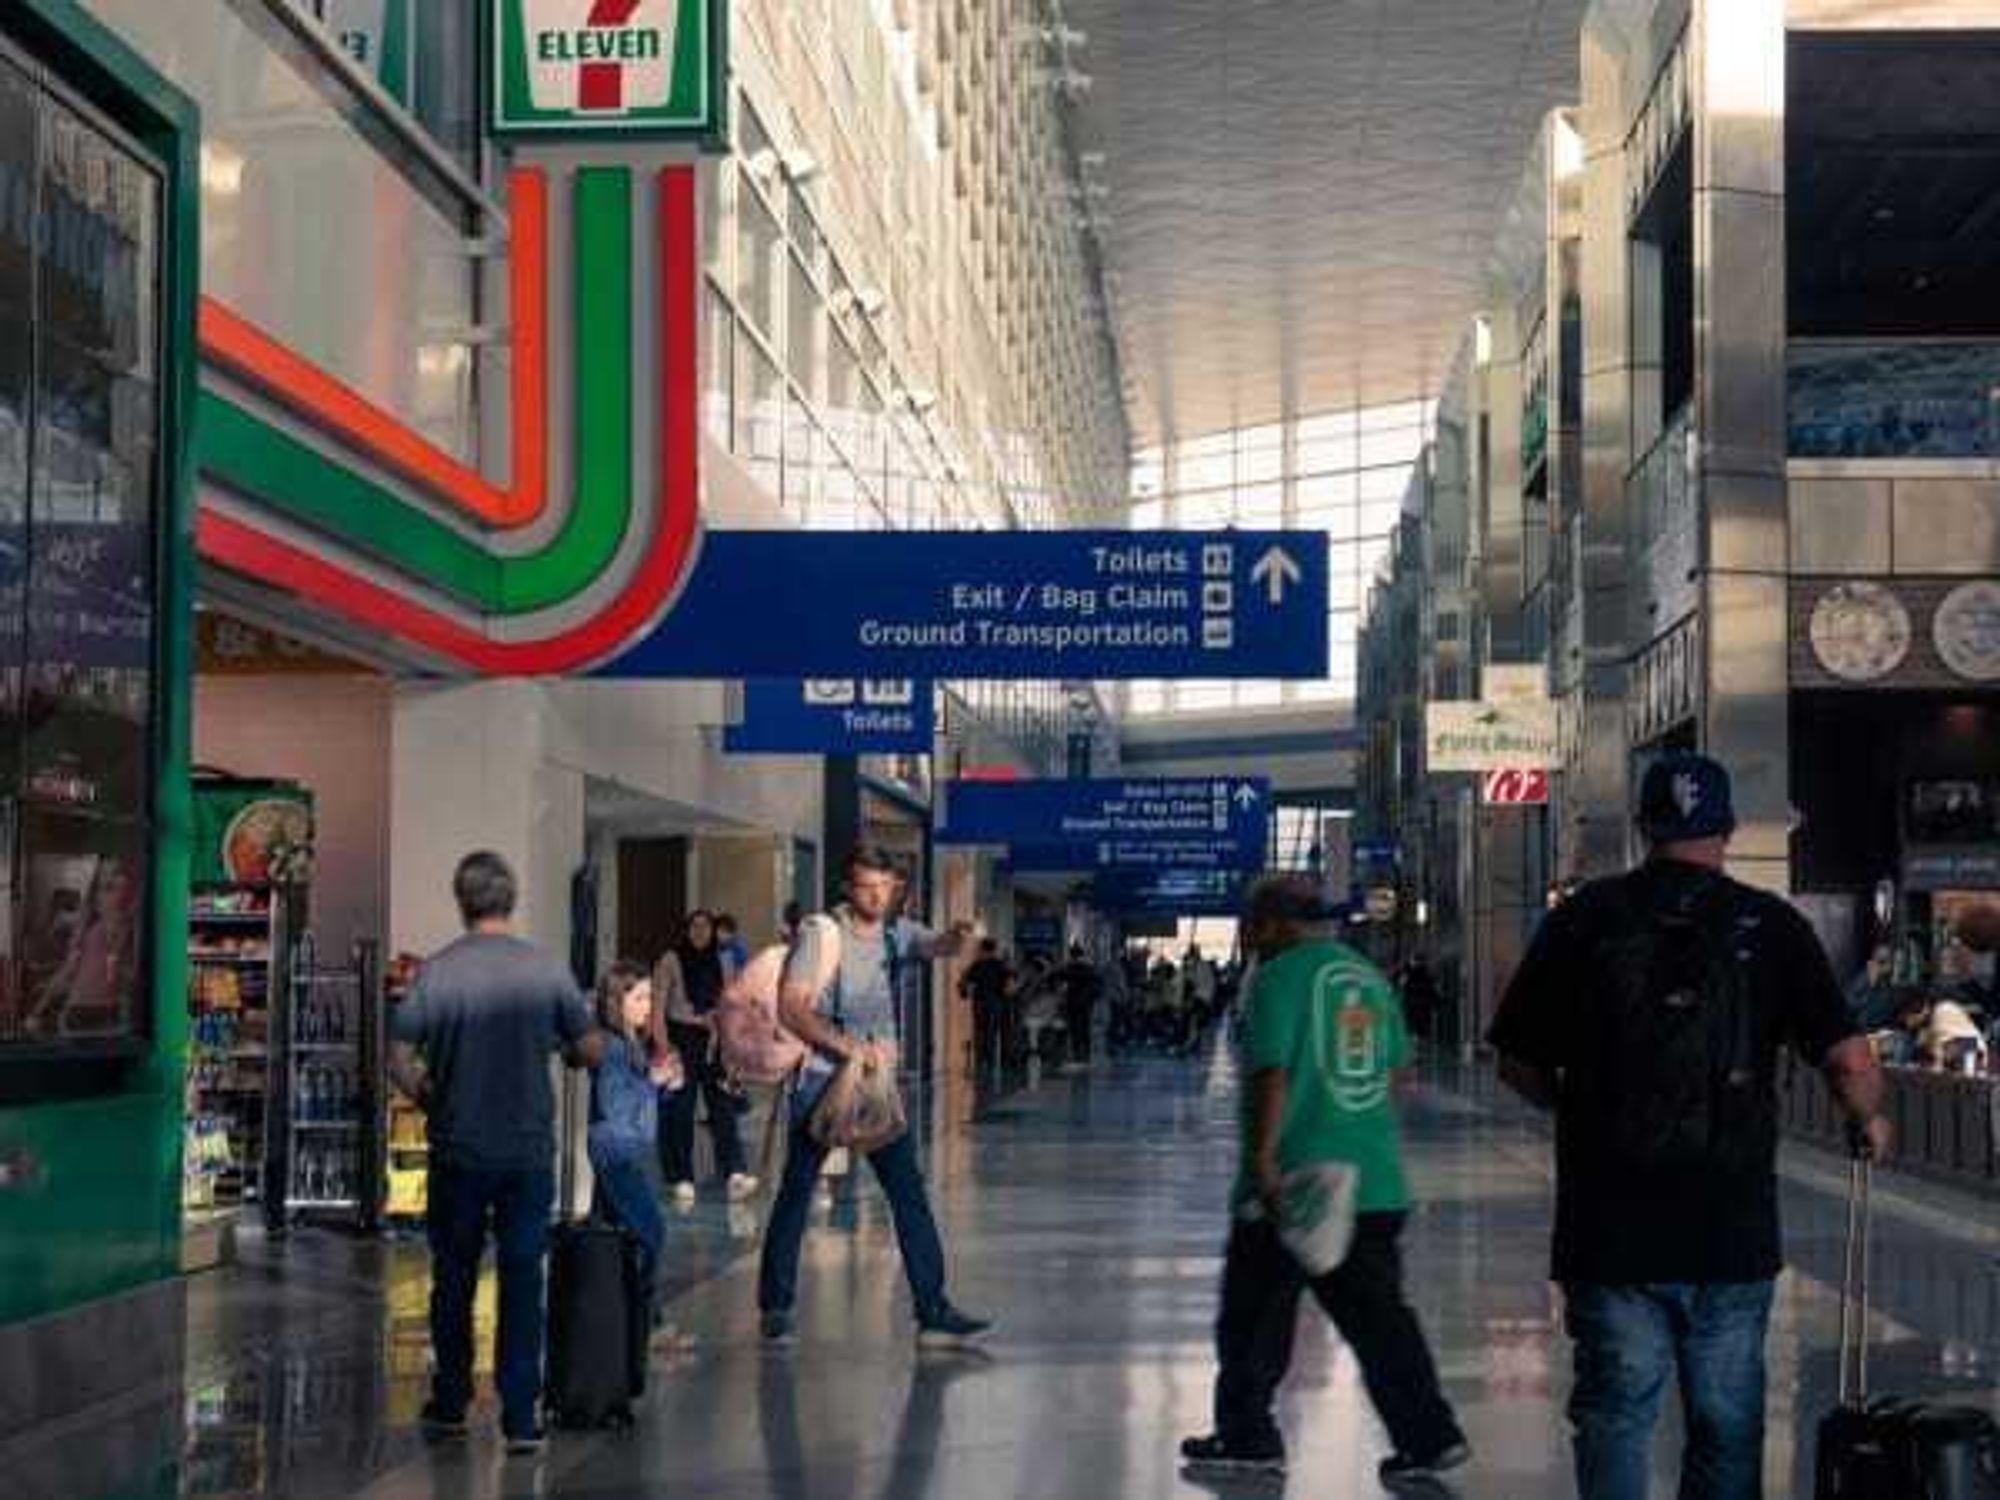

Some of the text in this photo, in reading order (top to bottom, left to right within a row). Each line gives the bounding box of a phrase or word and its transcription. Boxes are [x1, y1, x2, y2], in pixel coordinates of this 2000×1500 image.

[1093, 547, 1190, 574] Toilets
[952, 585, 1190, 614] Exit / Bag Claim
[859, 621, 1190, 651] Ground Transportation
